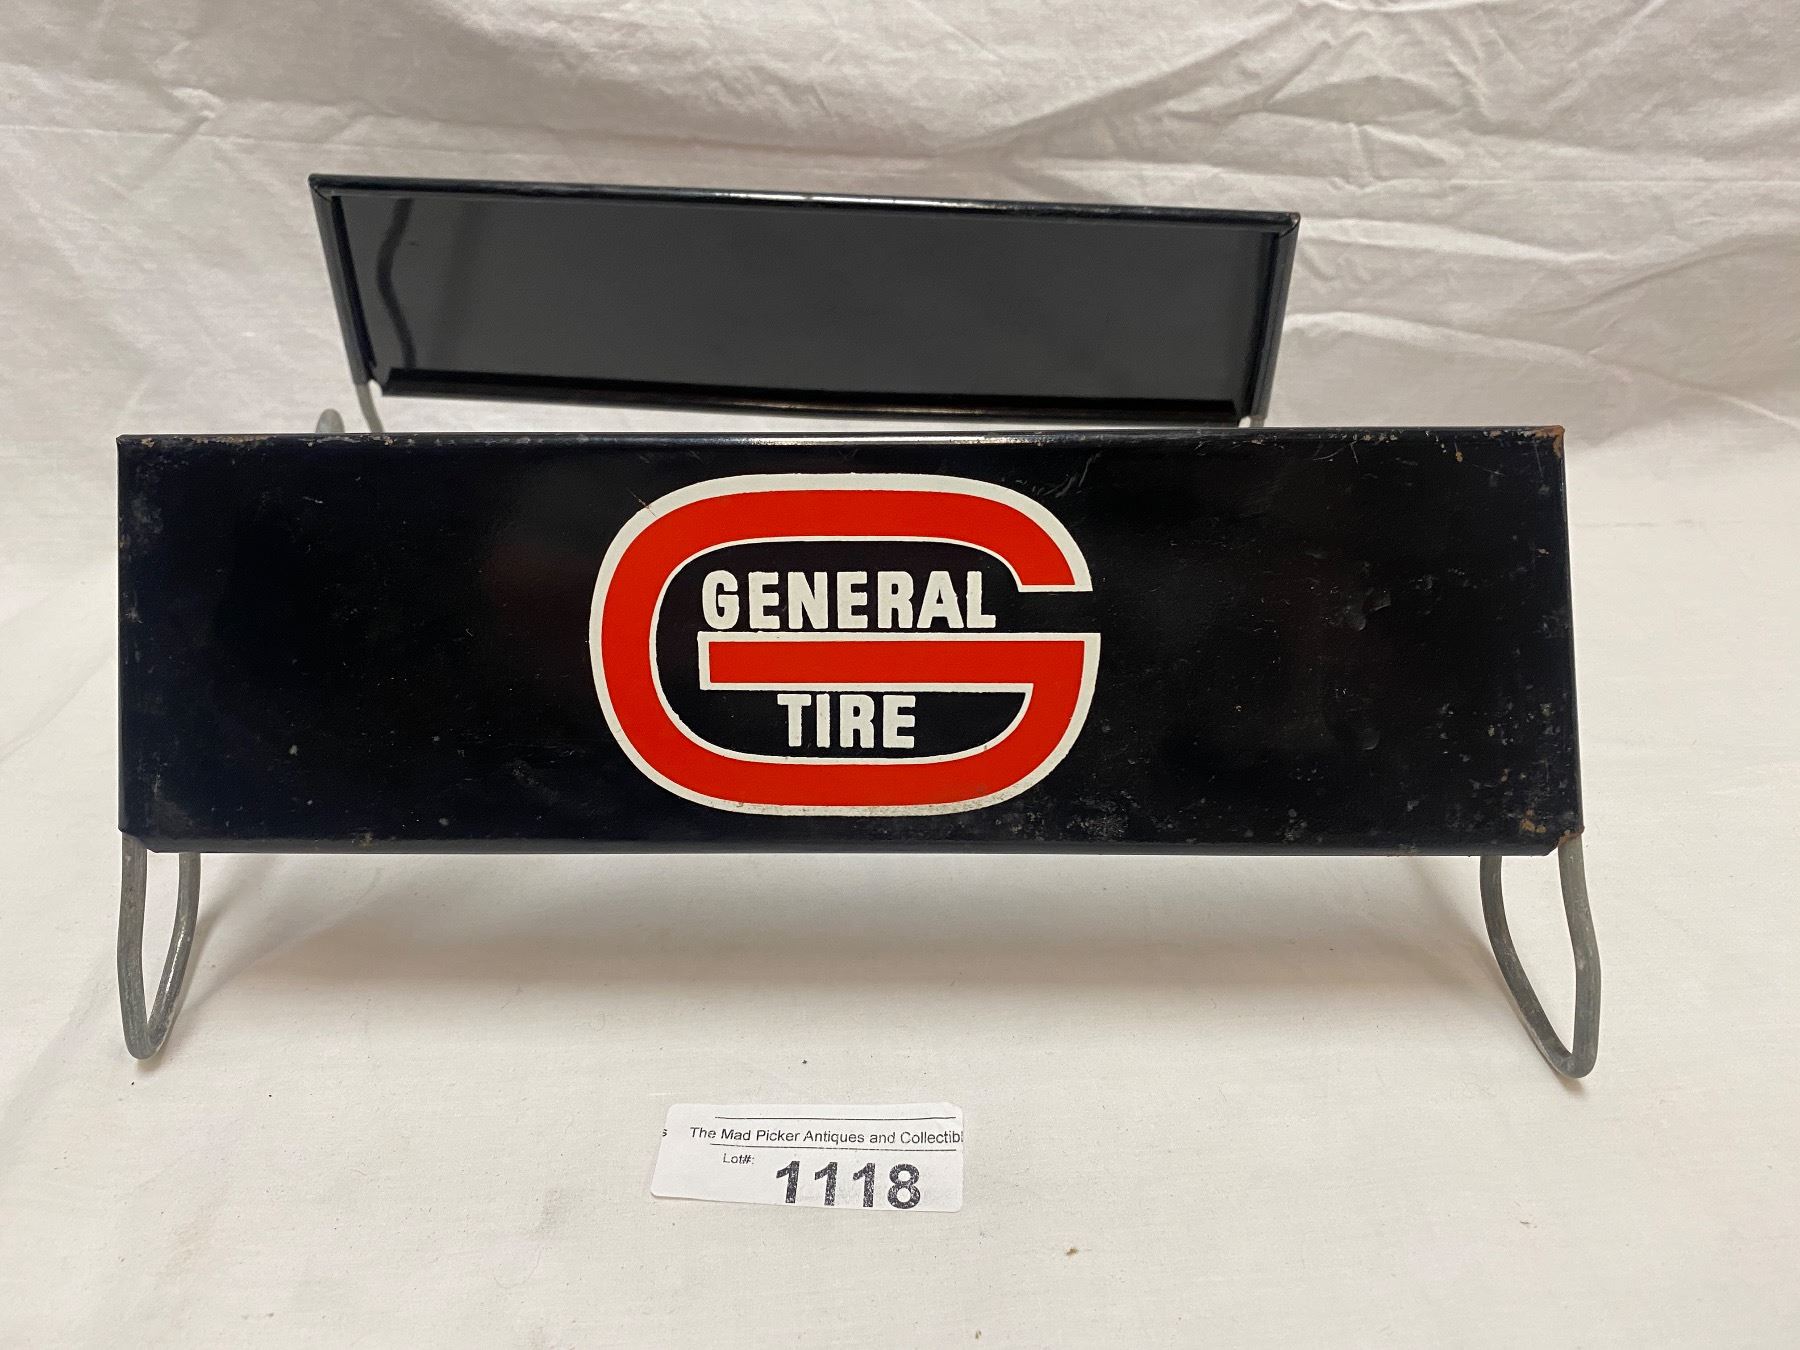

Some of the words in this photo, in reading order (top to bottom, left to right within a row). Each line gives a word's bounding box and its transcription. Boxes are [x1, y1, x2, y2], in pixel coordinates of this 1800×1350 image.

[702, 570, 996, 630] GENERAL
[589, 473, 1101, 817] G
[777, 693, 916, 749] TIRE
[689, 1126, 717, 1139] The
[720, 1128, 751, 1141] Mad
[756, 1129, 800, 1142] Picker
[803, 1130, 865, 1146] Antiques
[869, 1131, 896, 1144] and
[722, 1152, 755, 1165] Lot#:
[776, 1160, 921, 1209] 1118
